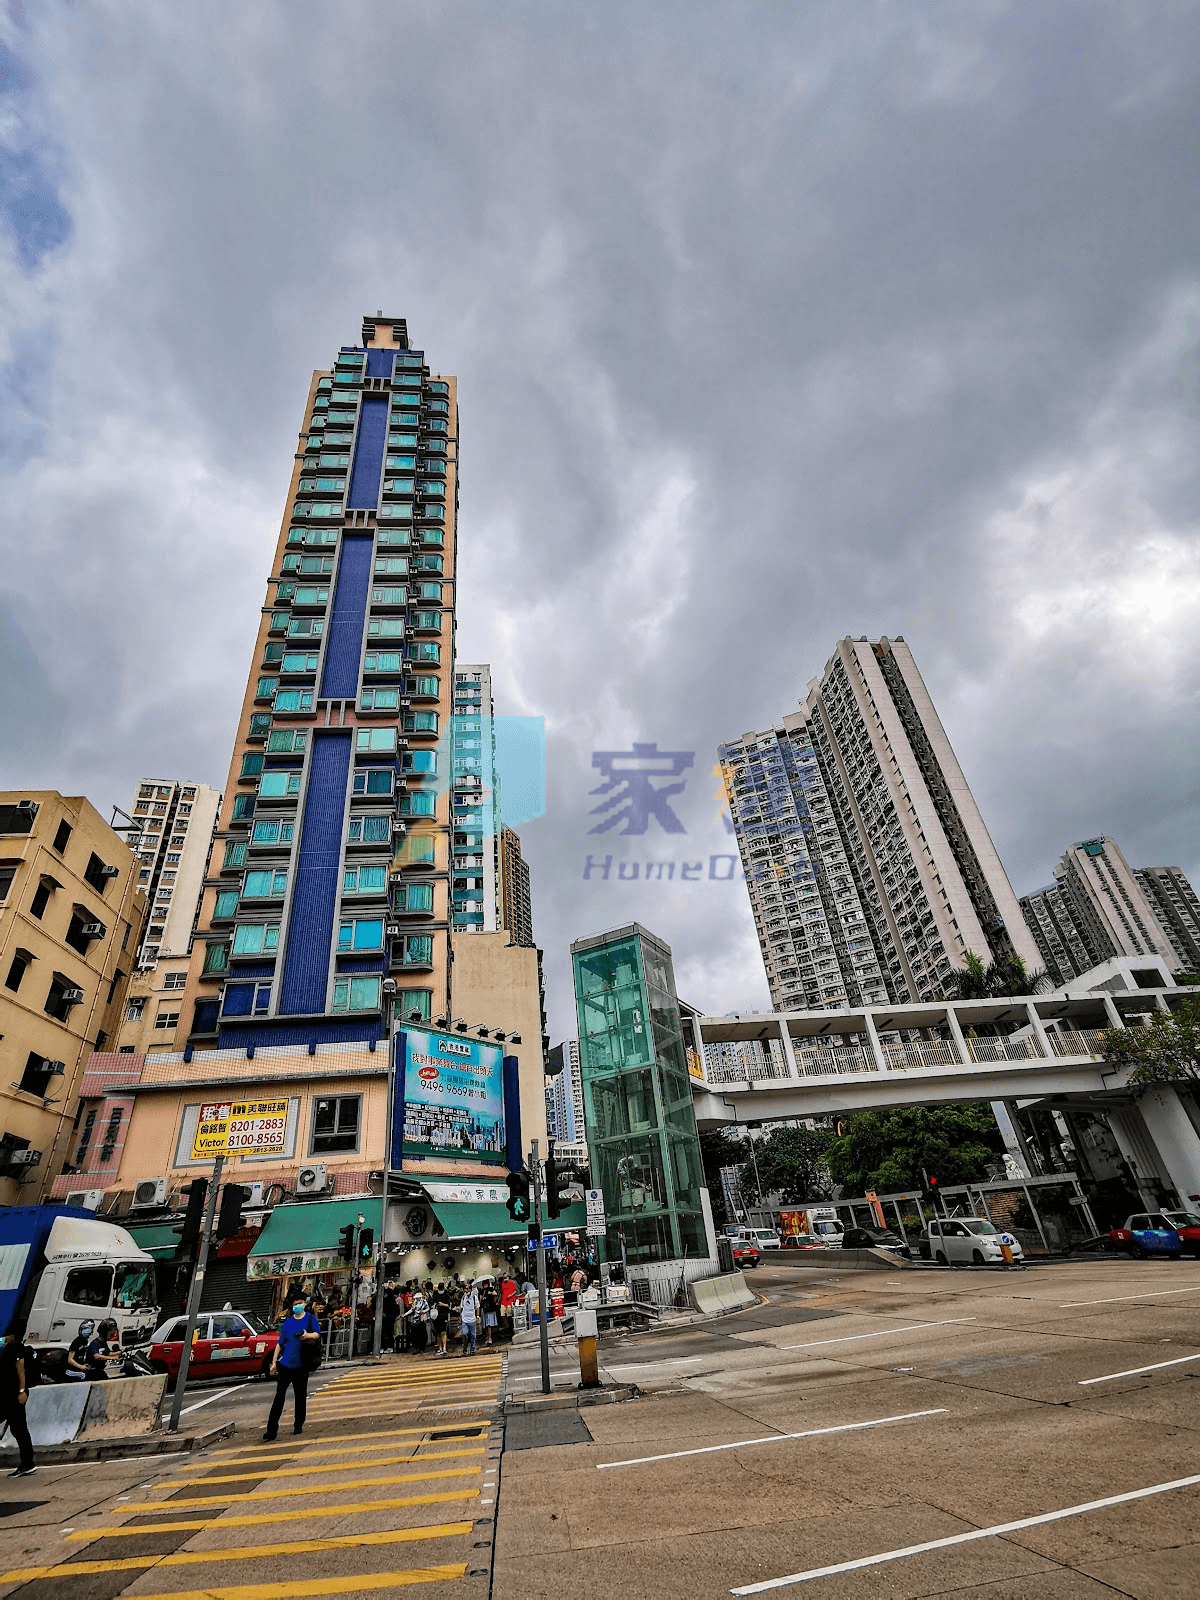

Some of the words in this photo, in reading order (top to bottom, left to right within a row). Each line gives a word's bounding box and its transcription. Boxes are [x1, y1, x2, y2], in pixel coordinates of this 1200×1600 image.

[420, 1079, 444, 1092] 9496
[230, 1118, 284, 1132] 8201-2883
[199, 1139, 225, 1148] Victor
[228, 1132, 283, 1147] 8100-8565
